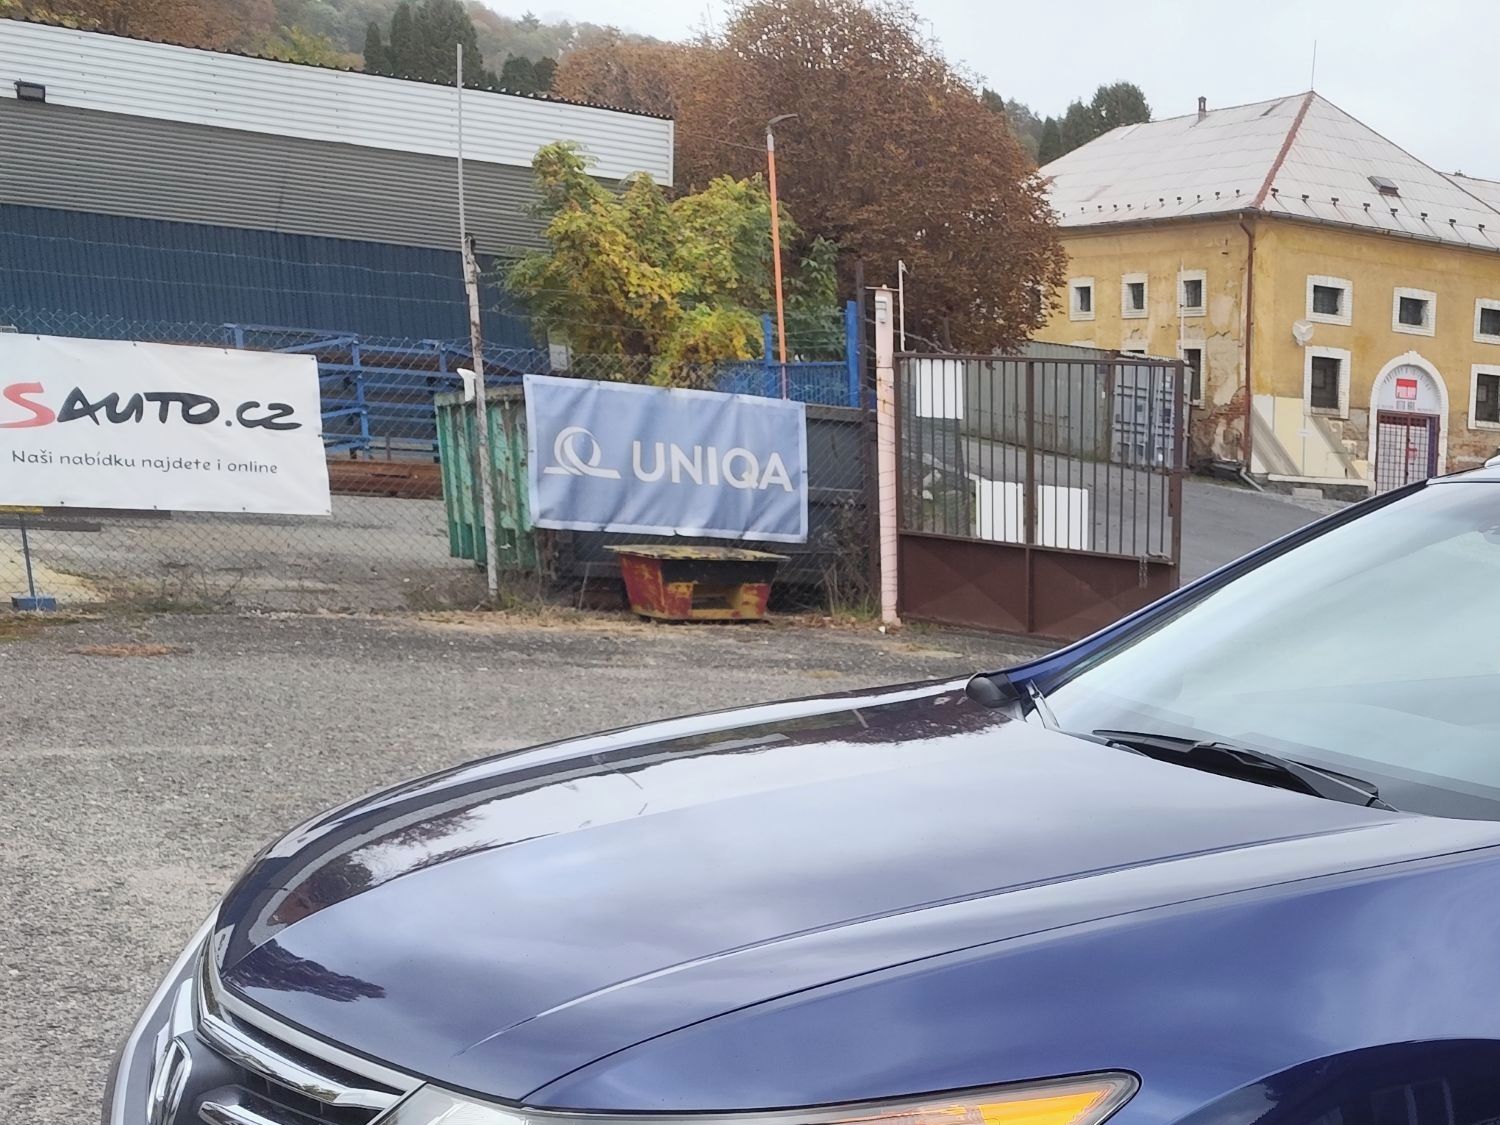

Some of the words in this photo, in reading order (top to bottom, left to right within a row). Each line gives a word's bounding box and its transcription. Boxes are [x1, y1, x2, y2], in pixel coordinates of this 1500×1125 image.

[12, 449, 53, 464] Naši
[60, 452, 136, 468] nabídku
[141, 456, 212, 473] najdete
[217, 459, 222, 471] i
[228, 461, 278, 474] online
[632, 440, 794, 492] UNIQA
